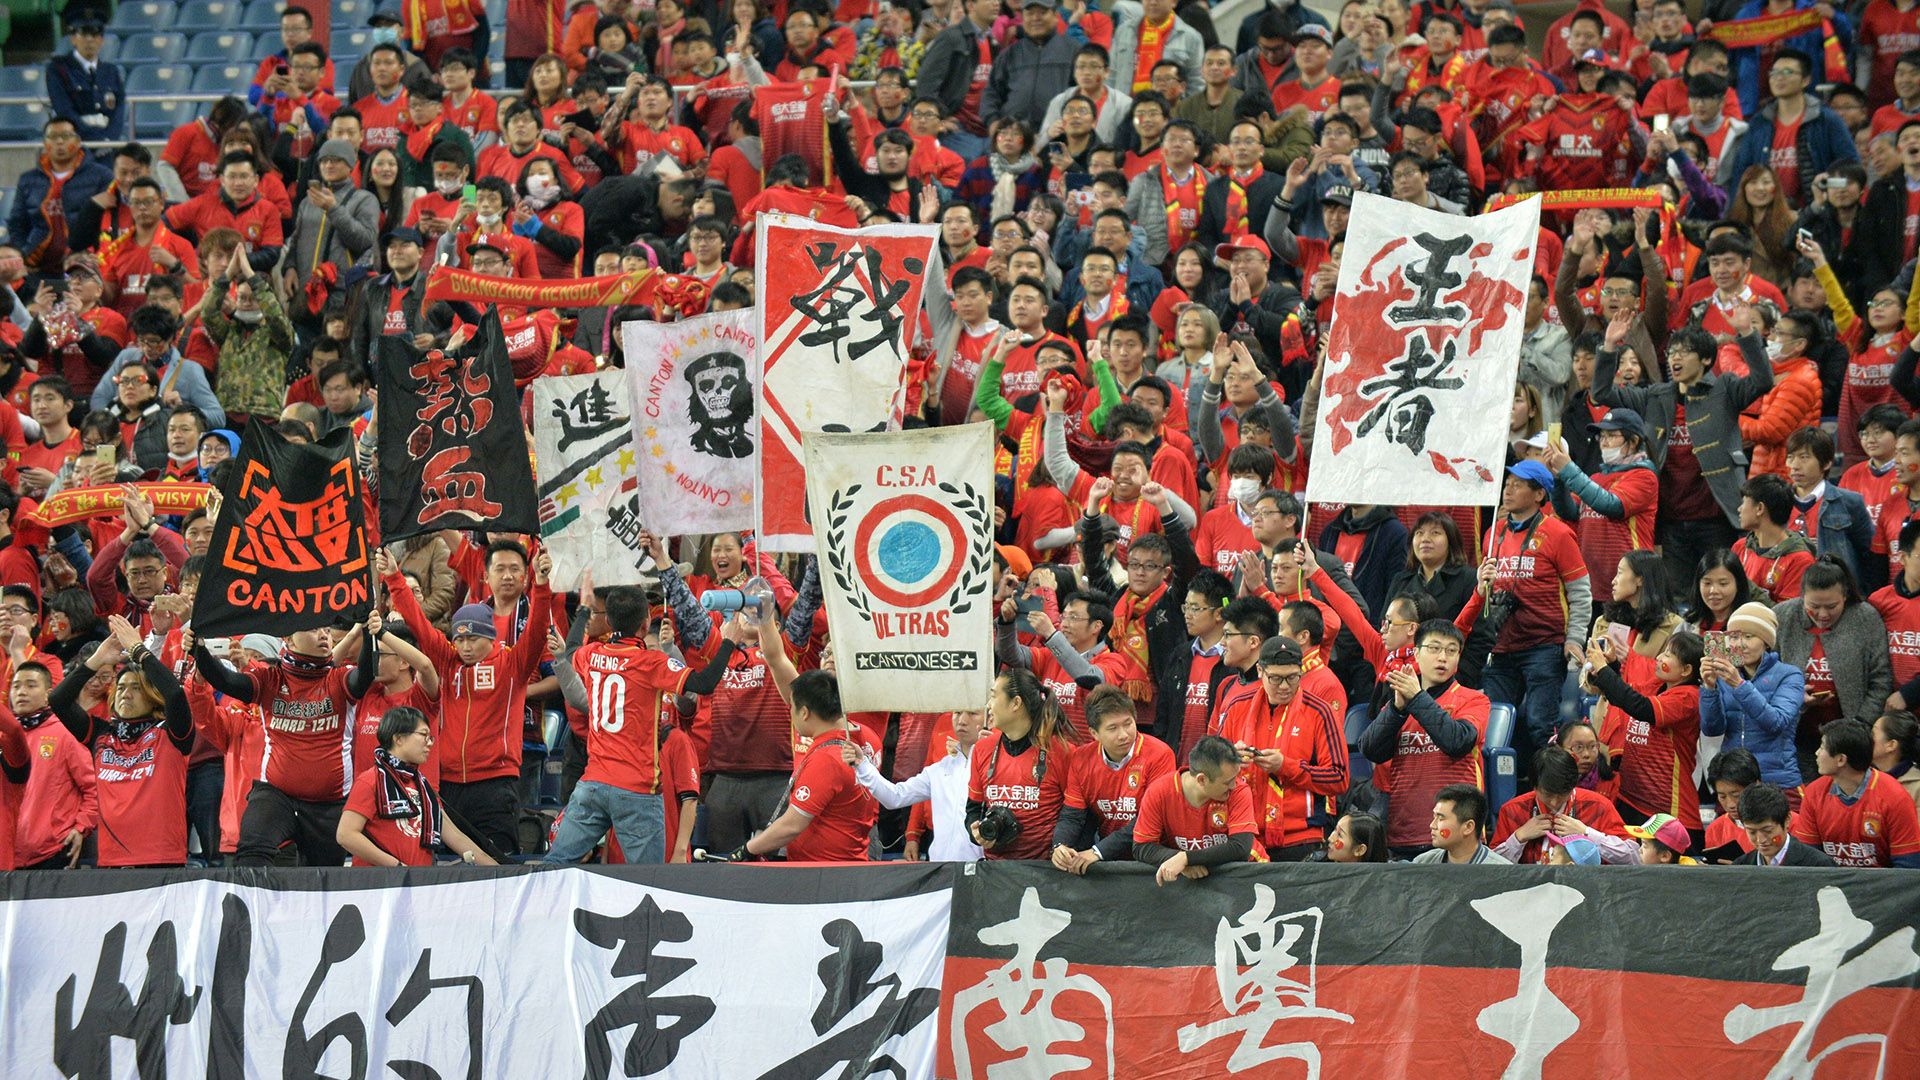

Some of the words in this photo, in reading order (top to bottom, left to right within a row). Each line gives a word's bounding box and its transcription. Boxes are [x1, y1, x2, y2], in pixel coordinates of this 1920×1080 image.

[450, 272, 537, 301] GUANGZHOU
[540, 281, 600, 301] HENGDA
[1357, 231, 1474, 456] 王者
[645, 358, 674, 419] CANTON
[553, 378, 632, 453] 進
[1018, 425, 1034, 466] SHINE
[677, 473, 731, 507] CANTON
[876, 465, 936, 487] C.S.A
[155, 491, 191, 506] ASIA
[227, 573, 368, 614] CANTON
[872, 609, 950, 640] ULTRAS
[590, 653, 619, 671] ZHENG
[869, 652, 960, 669] CANTONESE
[473, 665, 494, 692] 国
[589, 670, 626, 734] 10
[269, 714, 339, 733] GUARD-12TH
[986, 784, 1040, 801] 恒大金服
[1174, 834, 1228, 849] 恒大金服
[1822, 841, 1876, 858] 恒大金服
